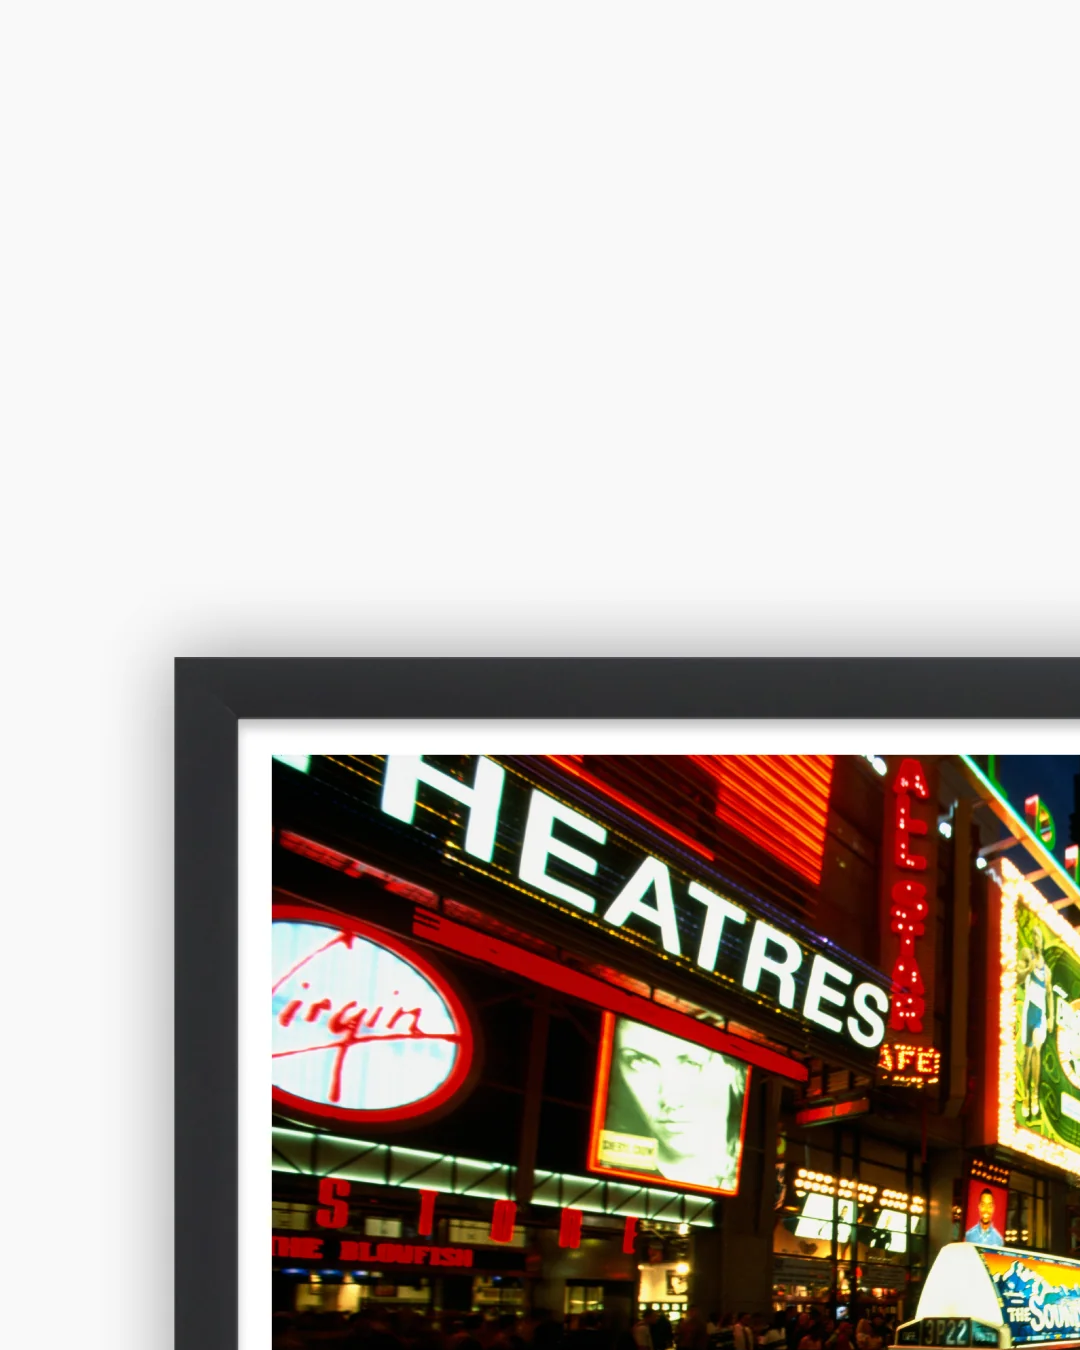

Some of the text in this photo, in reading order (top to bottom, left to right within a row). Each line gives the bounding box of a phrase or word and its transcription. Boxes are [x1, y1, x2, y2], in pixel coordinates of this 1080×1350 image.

[272, 755, 890, 1049] HEATRES
[877, 1047, 936, 1074] AFE
[1007, 1307, 1031, 1322] THE
[924, 1318, 970, 1346] 3P22
